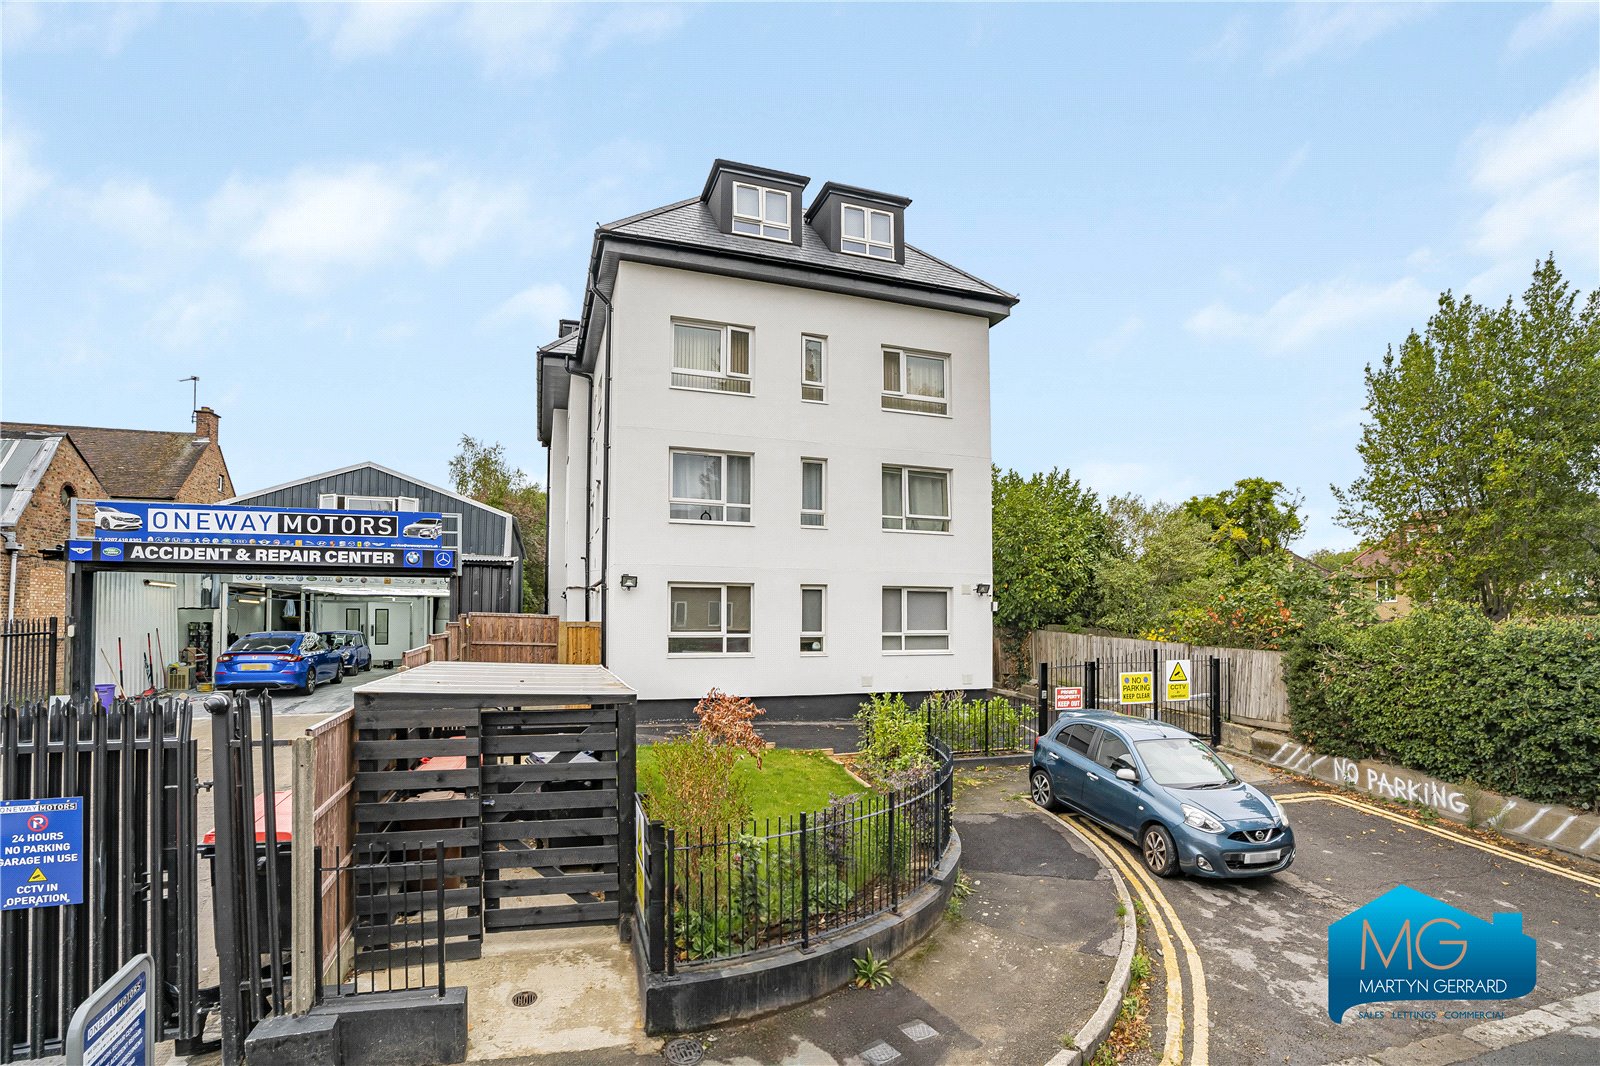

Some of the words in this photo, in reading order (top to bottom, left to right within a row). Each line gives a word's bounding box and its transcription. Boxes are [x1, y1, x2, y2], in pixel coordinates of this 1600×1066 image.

[152, 511, 273, 533] ONEWAY
[282, 515, 393, 536] MOTORS
[130, 545, 233, 562] ACCIDENT
[235, 547, 250, 562] &
[255, 548, 322, 563] REPAIR
[324, 549, 395, 565] CENTER
[1131, 676, 1142, 684] NO
[1122, 684, 1151, 692] PARKING
[1333, 757, 1359, 785] NO
[0, 806, 37, 814] ONEWAY
[39, 803, 76, 811] MOTORS
[11, 834, 25, 844] 24
[27, 832, 64, 842] HOURS
[4, 846, 21, 855] NO
[23, 842, 71, 854] PARKING
[43, 855, 55, 864] IN
[57, 853, 78, 863] USE
[16, 884, 45, 894] CCTV
[46, 883, 58, 892] IN
[6, 893, 68, 907] OPERATION
[90, 1006, 118, 1038] ONEWAY
[118, 979, 142, 1011] MOTORS
